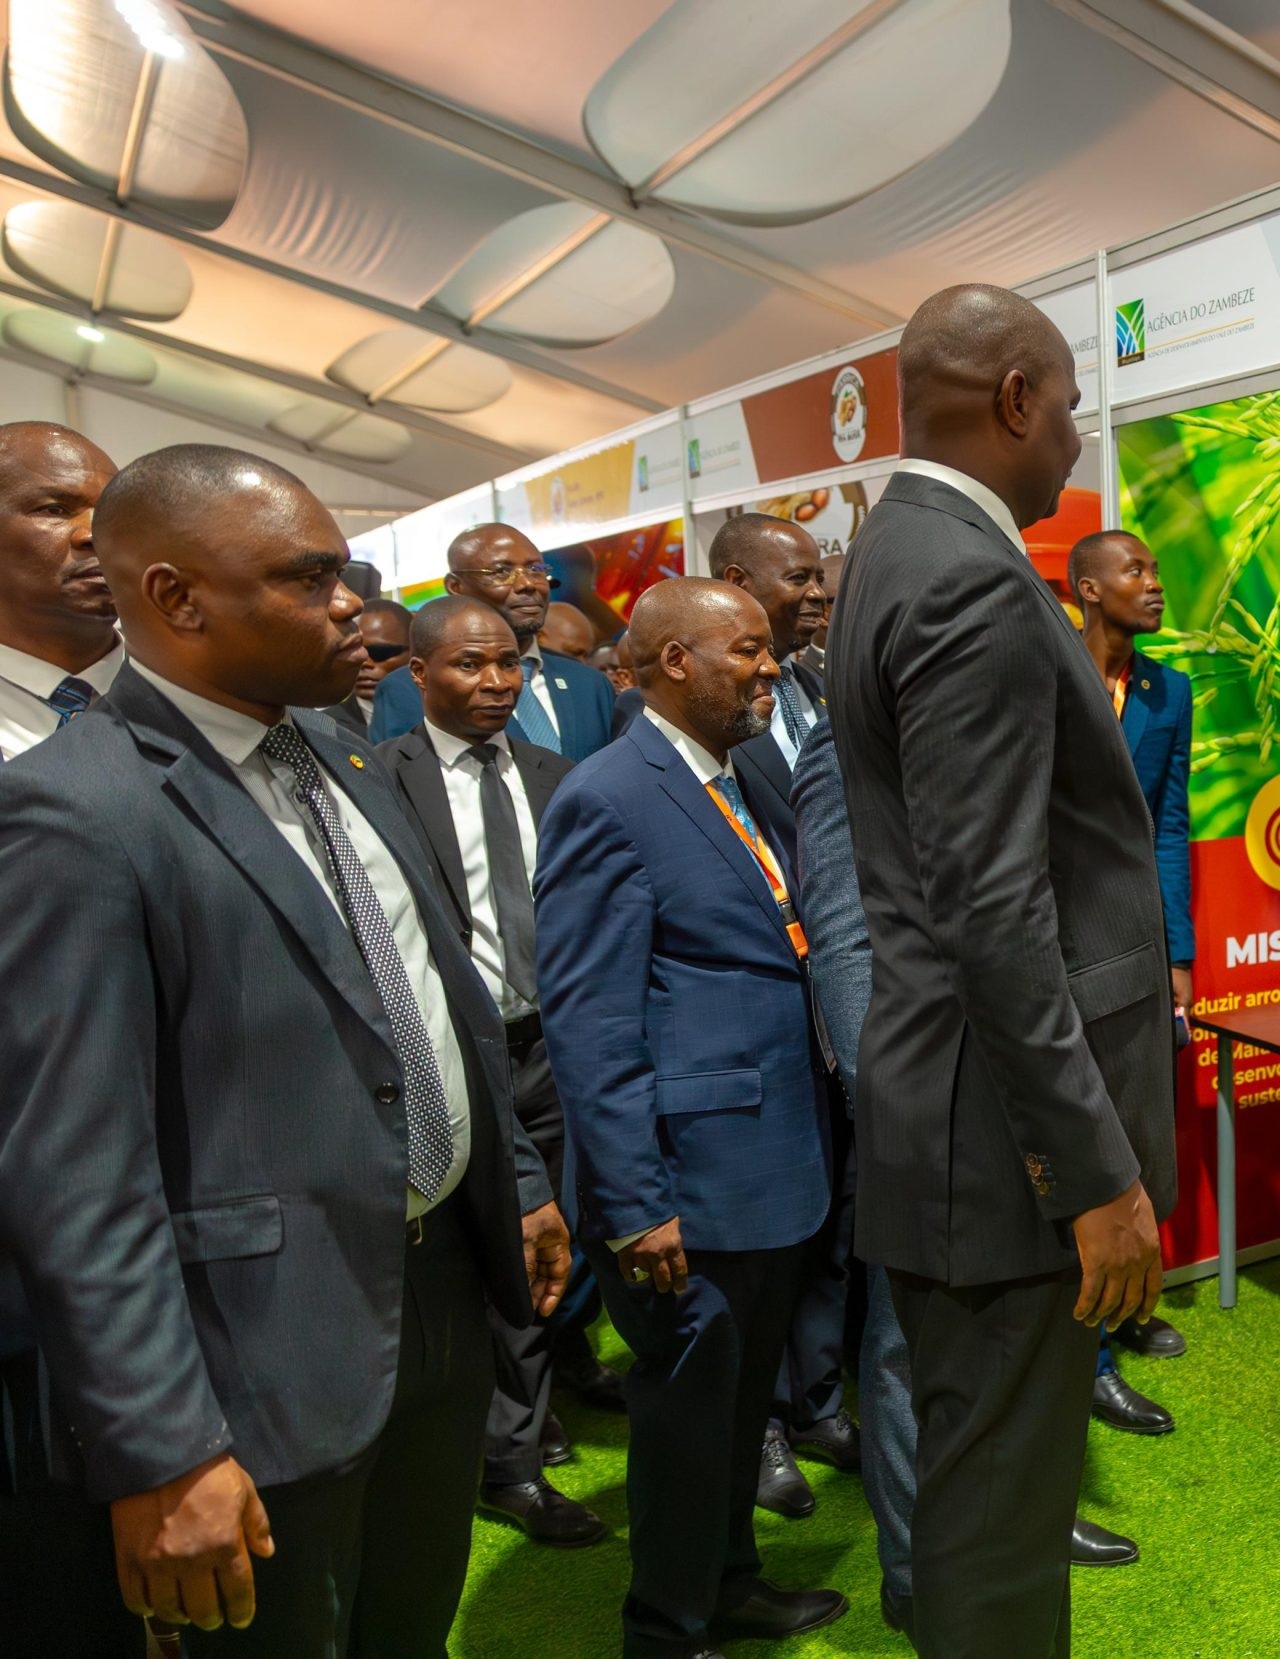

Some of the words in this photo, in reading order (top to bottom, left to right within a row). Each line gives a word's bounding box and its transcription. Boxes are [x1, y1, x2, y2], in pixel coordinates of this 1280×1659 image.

[1146, 310, 1189, 334] AGÊNCIA
[1190, 303, 1207, 319] DO
[1208, 286, 1256, 315] ZAMBEZE
[1193, 993, 1242, 1016] duzir
